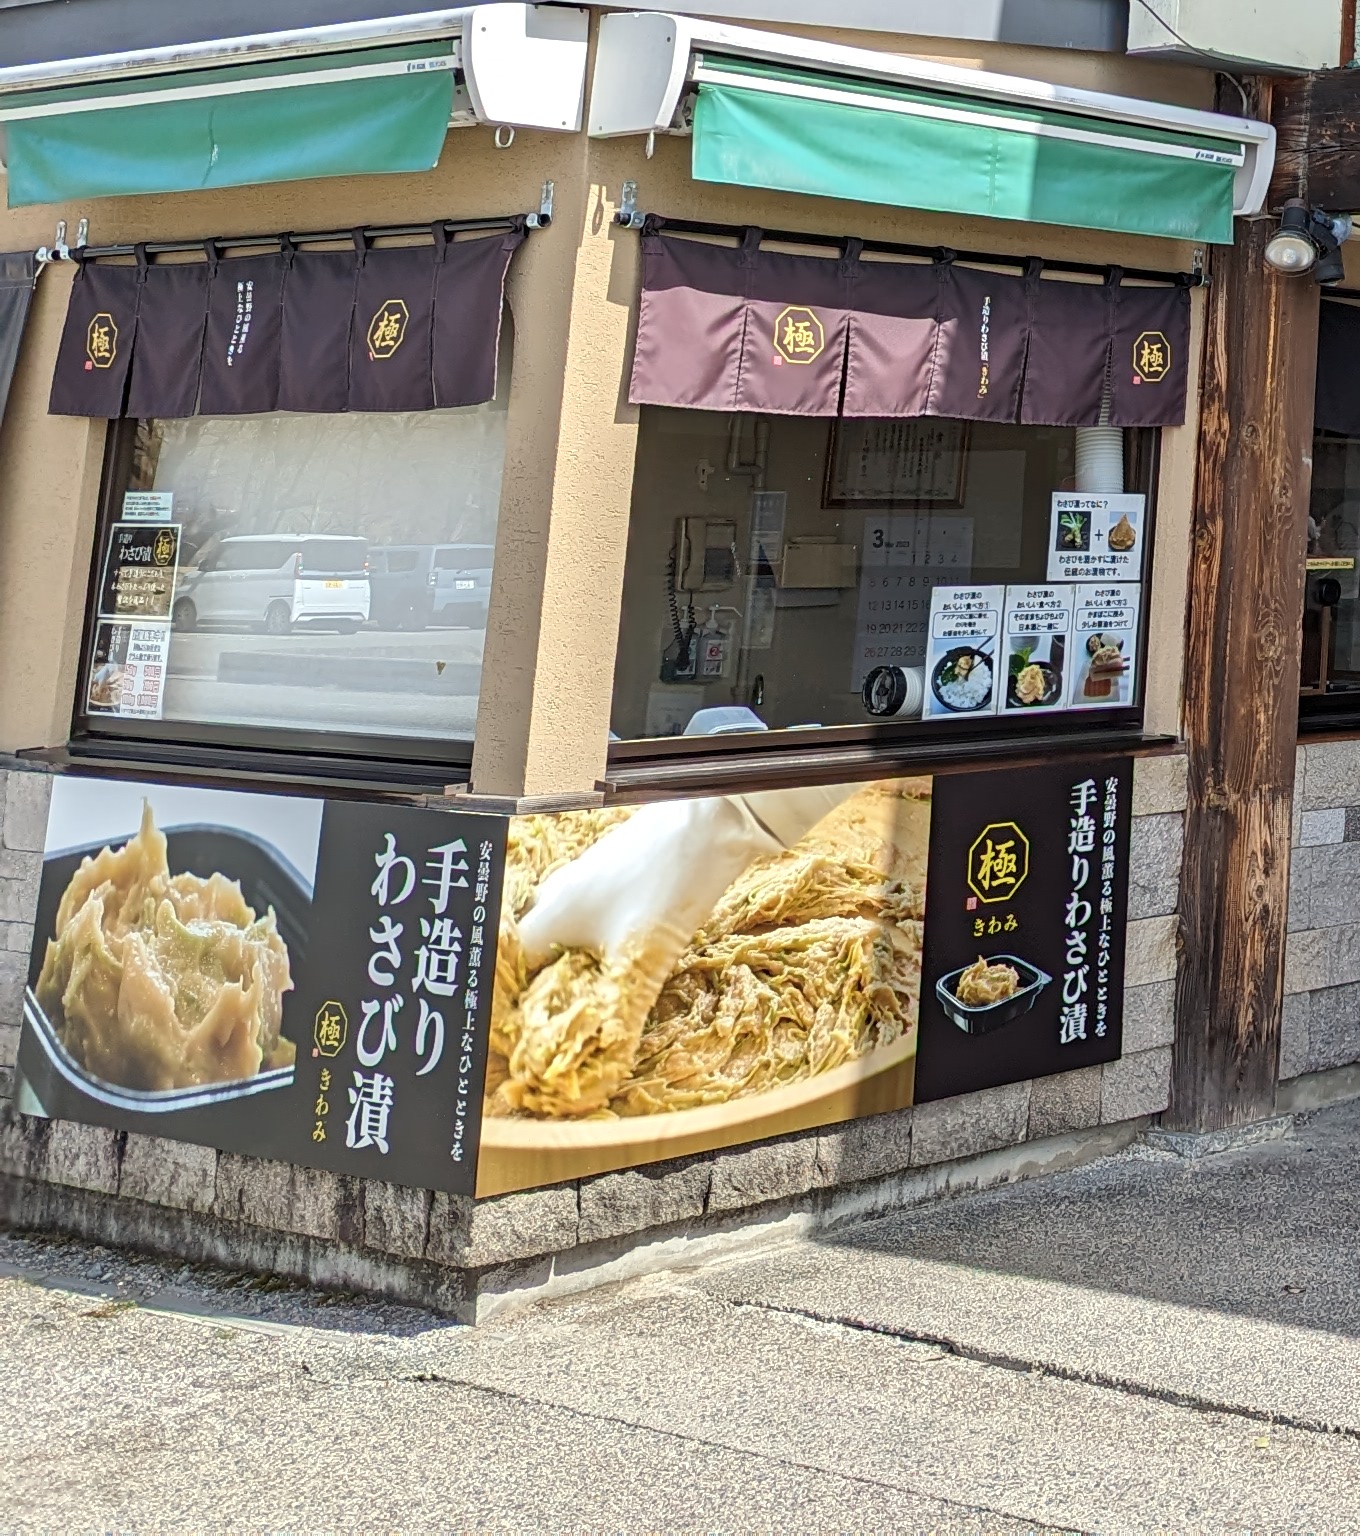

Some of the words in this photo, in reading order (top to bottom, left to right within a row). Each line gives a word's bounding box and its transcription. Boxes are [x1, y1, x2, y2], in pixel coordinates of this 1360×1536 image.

[92, 323, 111, 358] 極
[373, 311, 401, 349] 極
[786, 317, 815, 354] 極
[1140, 341, 1163, 374] 極
[119, 545, 152, 562] わさび漬
[156, 536, 170, 559] 極
[872, 529, 884, 548] 3
[912, 554, 916, 564] 1
[924, 554, 931, 564] 2
[938, 554, 945, 564] 3
[951, 554, 958, 563] 4
[882, 577, 889, 586] 6
[896, 577, 902, 586] 7
[909, 577, 916, 586] 8
[922, 577, 930, 587] 9
[881, 601, 891, 610] 13
[894, 600, 904, 609] 14
[908, 600, 918, 609] 15
[866, 624, 876, 633] 19
[879, 624, 890, 633] 20
[892, 624, 902, 633] 21
[905, 623, 918, 633] 22
[920, 623, 927, 632] 2
[877, 648, 888, 657] 27
[890, 647, 902, 657] 28
[904, 647, 916, 656] 29
[977, 839, 1017, 891] 極
[1059, 778, 1098, 1044] 手造りわさび漬
[1094, 776, 1118, 1037] 安曇野の風薫る極上なひとときを
[972, 914, 1018, 937] きわみ
[411, 838, 469, 1076] 手造り
[345, 833, 416, 1154] わさび漬
[450, 840, 493, 1162] 安曇野の風薫る極上なひとときを
[319, 1011, 341, 1047] 極
[311, 1068, 331, 1143] きわみ
